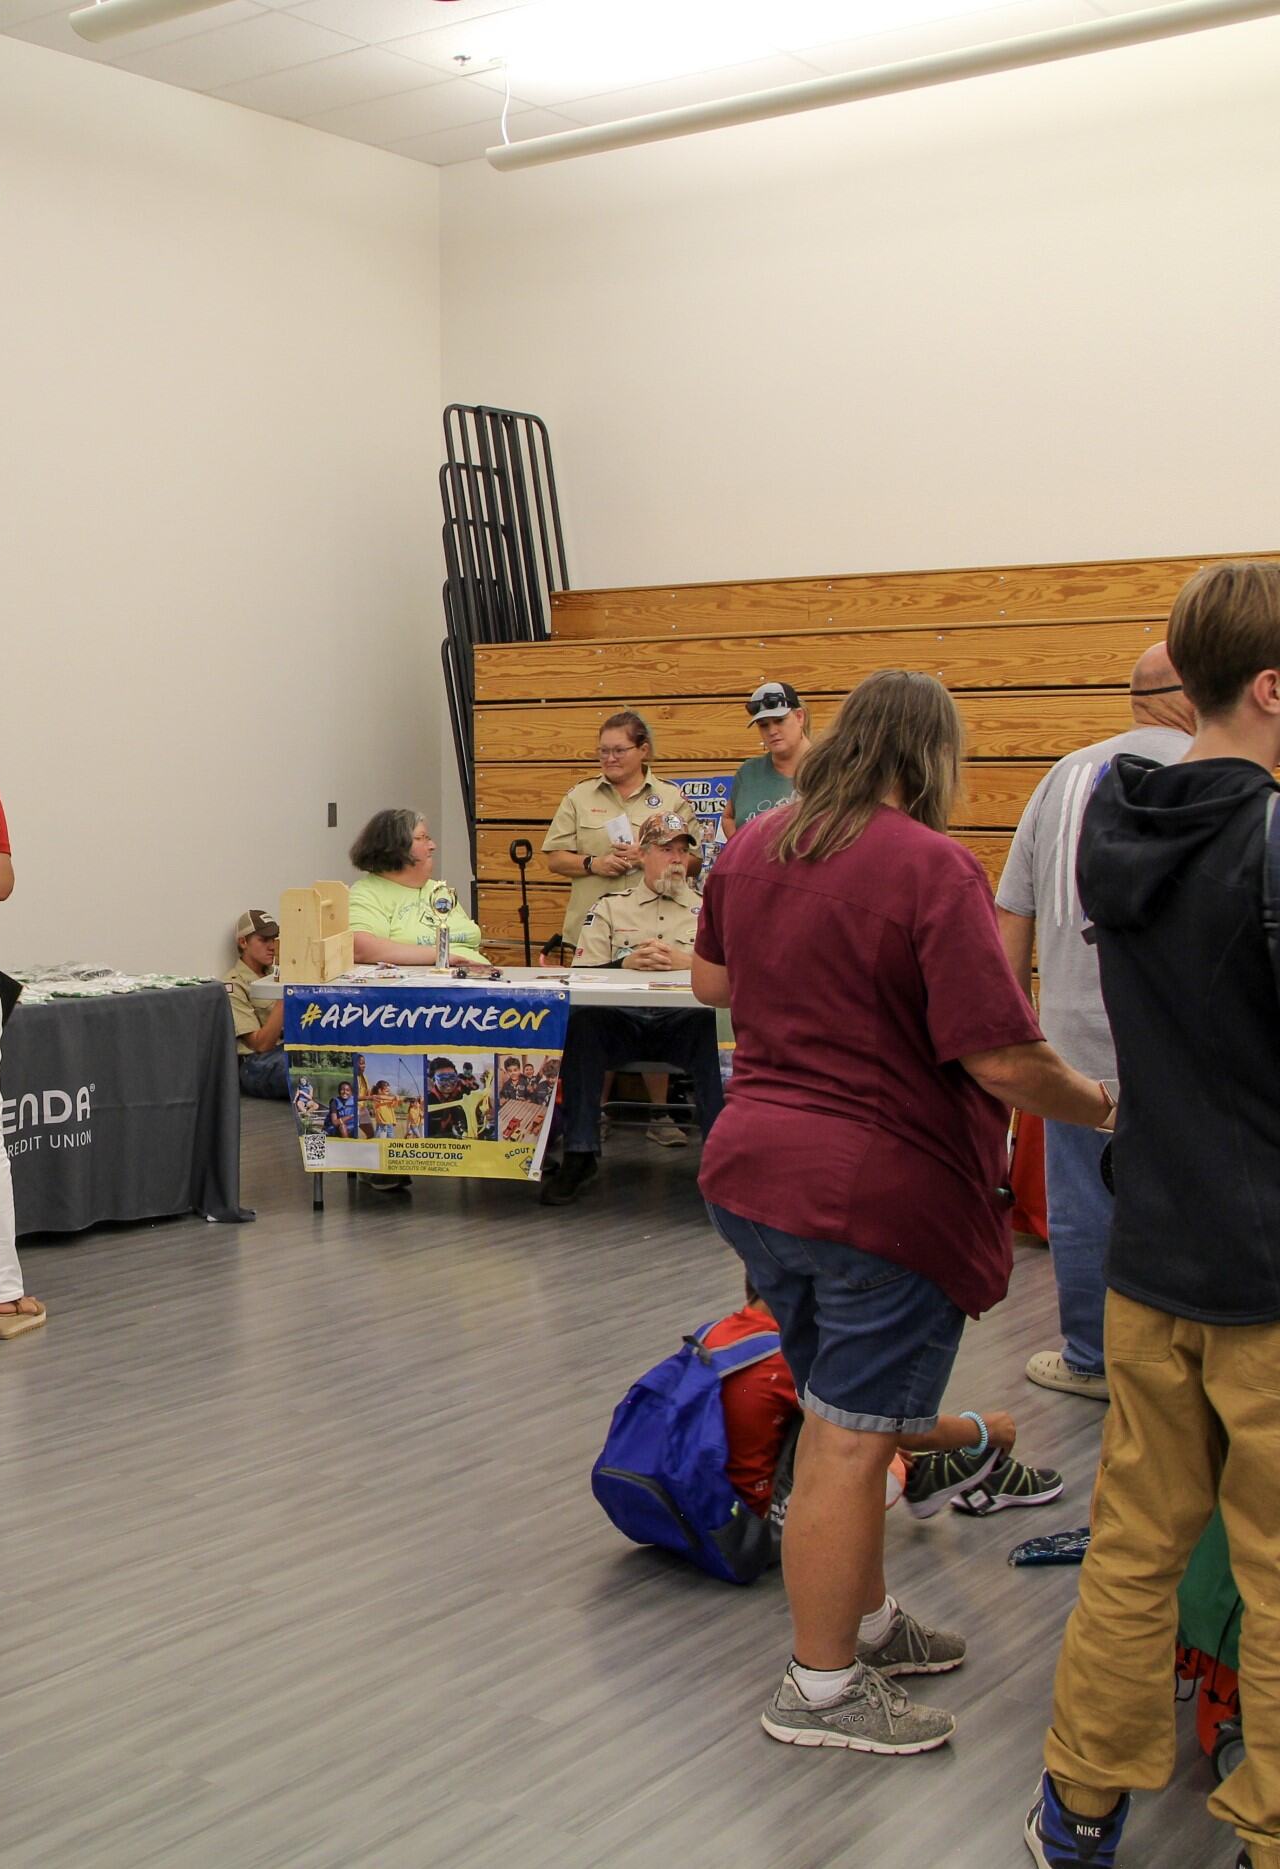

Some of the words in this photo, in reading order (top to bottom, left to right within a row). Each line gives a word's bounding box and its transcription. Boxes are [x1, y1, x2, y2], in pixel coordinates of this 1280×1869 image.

[682, 783, 710, 795] CUB
[300, 1002, 551, 1032] #ADVENTUREON
[6, 1136, 42, 1159] REDIT
[49, 1129, 92, 1149] UNION
[505, 1147, 529, 1160] SCOUT
[842, 1714, 865, 1723] FILA
[1076, 1824, 1101, 1838] NIKE
